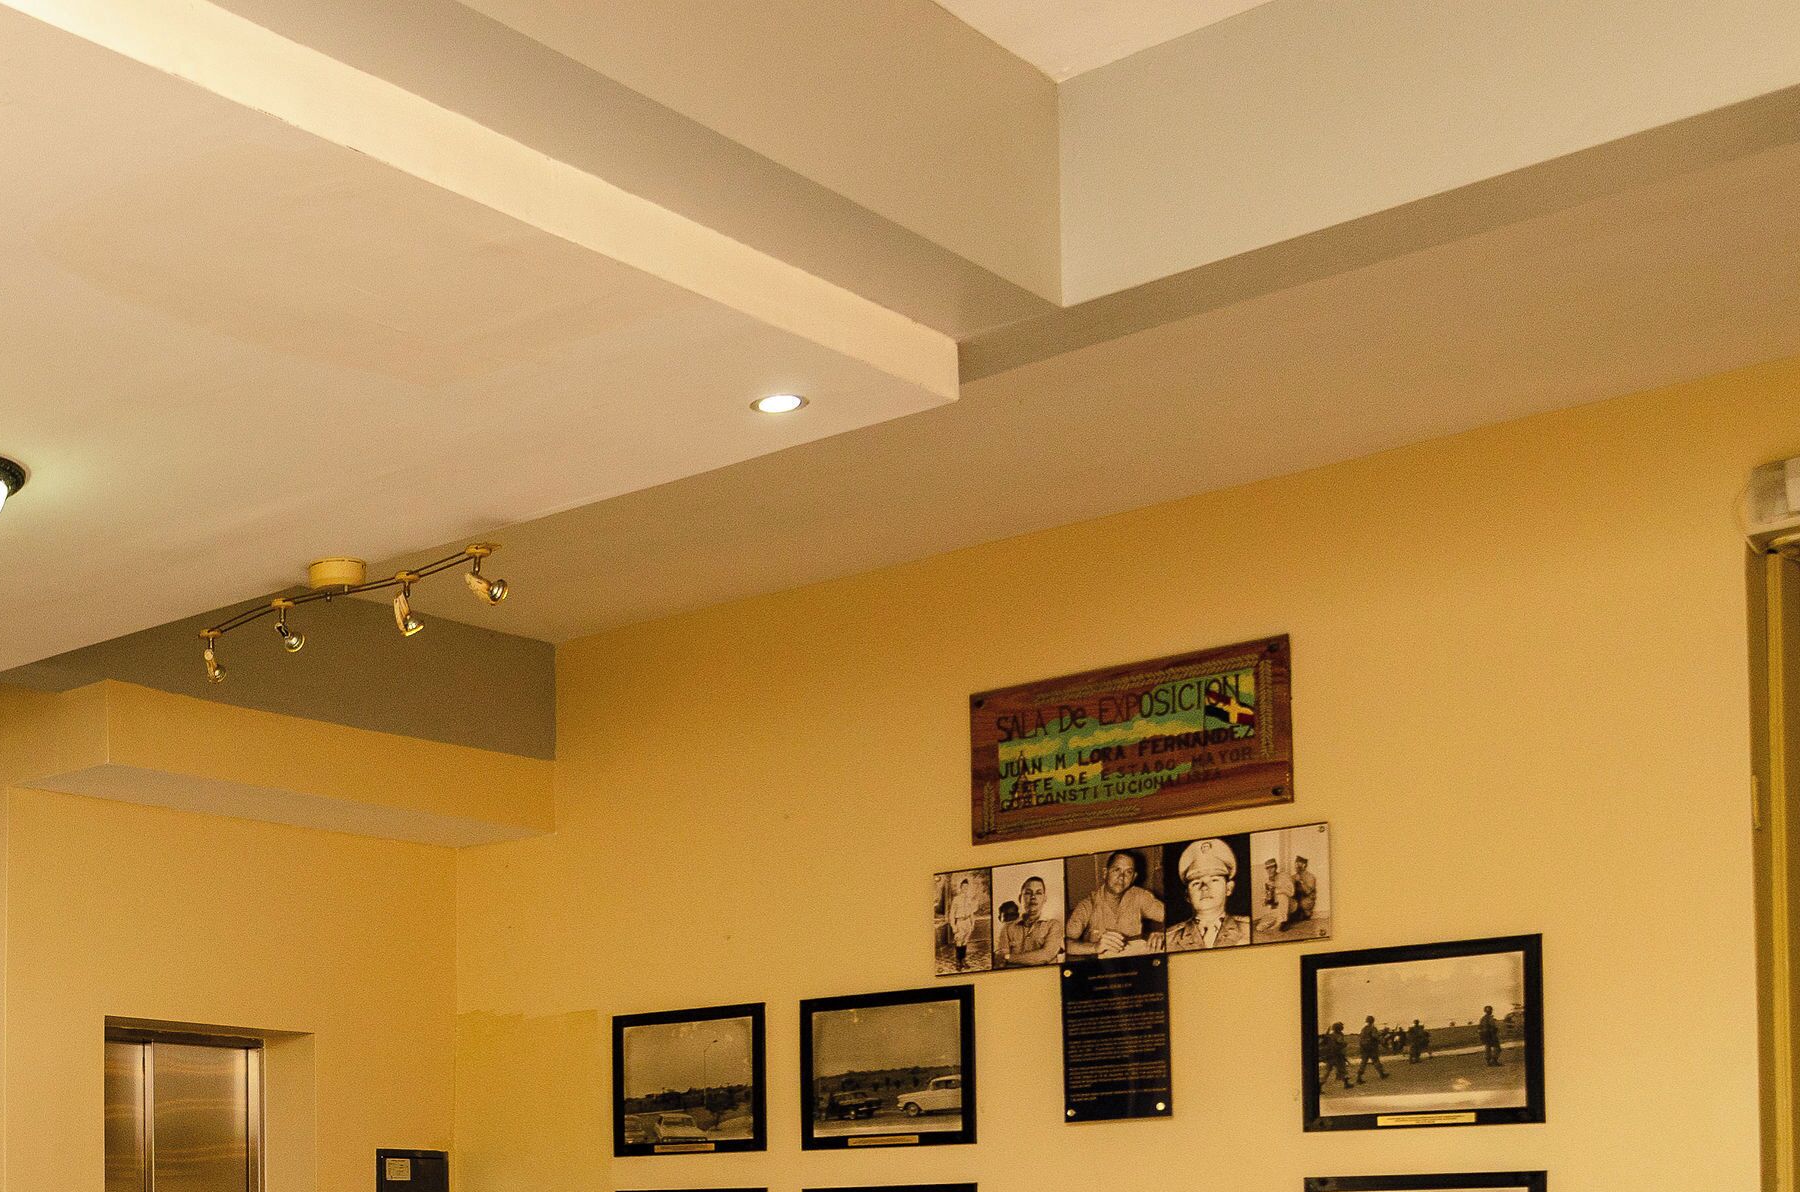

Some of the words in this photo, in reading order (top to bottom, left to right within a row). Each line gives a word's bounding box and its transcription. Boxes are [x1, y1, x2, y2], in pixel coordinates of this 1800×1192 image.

[997, 707, 1048, 742] SALA
[1098, 673, 1240, 726] EXPOSICION
[1000, 756, 1043, 780] JUAN
[1054, 752, 1067, 771] M
[1138, 724, 1255, 757] FERNANDEZ
[1065, 771, 1088, 787] DE
[1100, 758, 1177, 781] ESTADO
[1191, 745, 1255, 768] MAYOR
